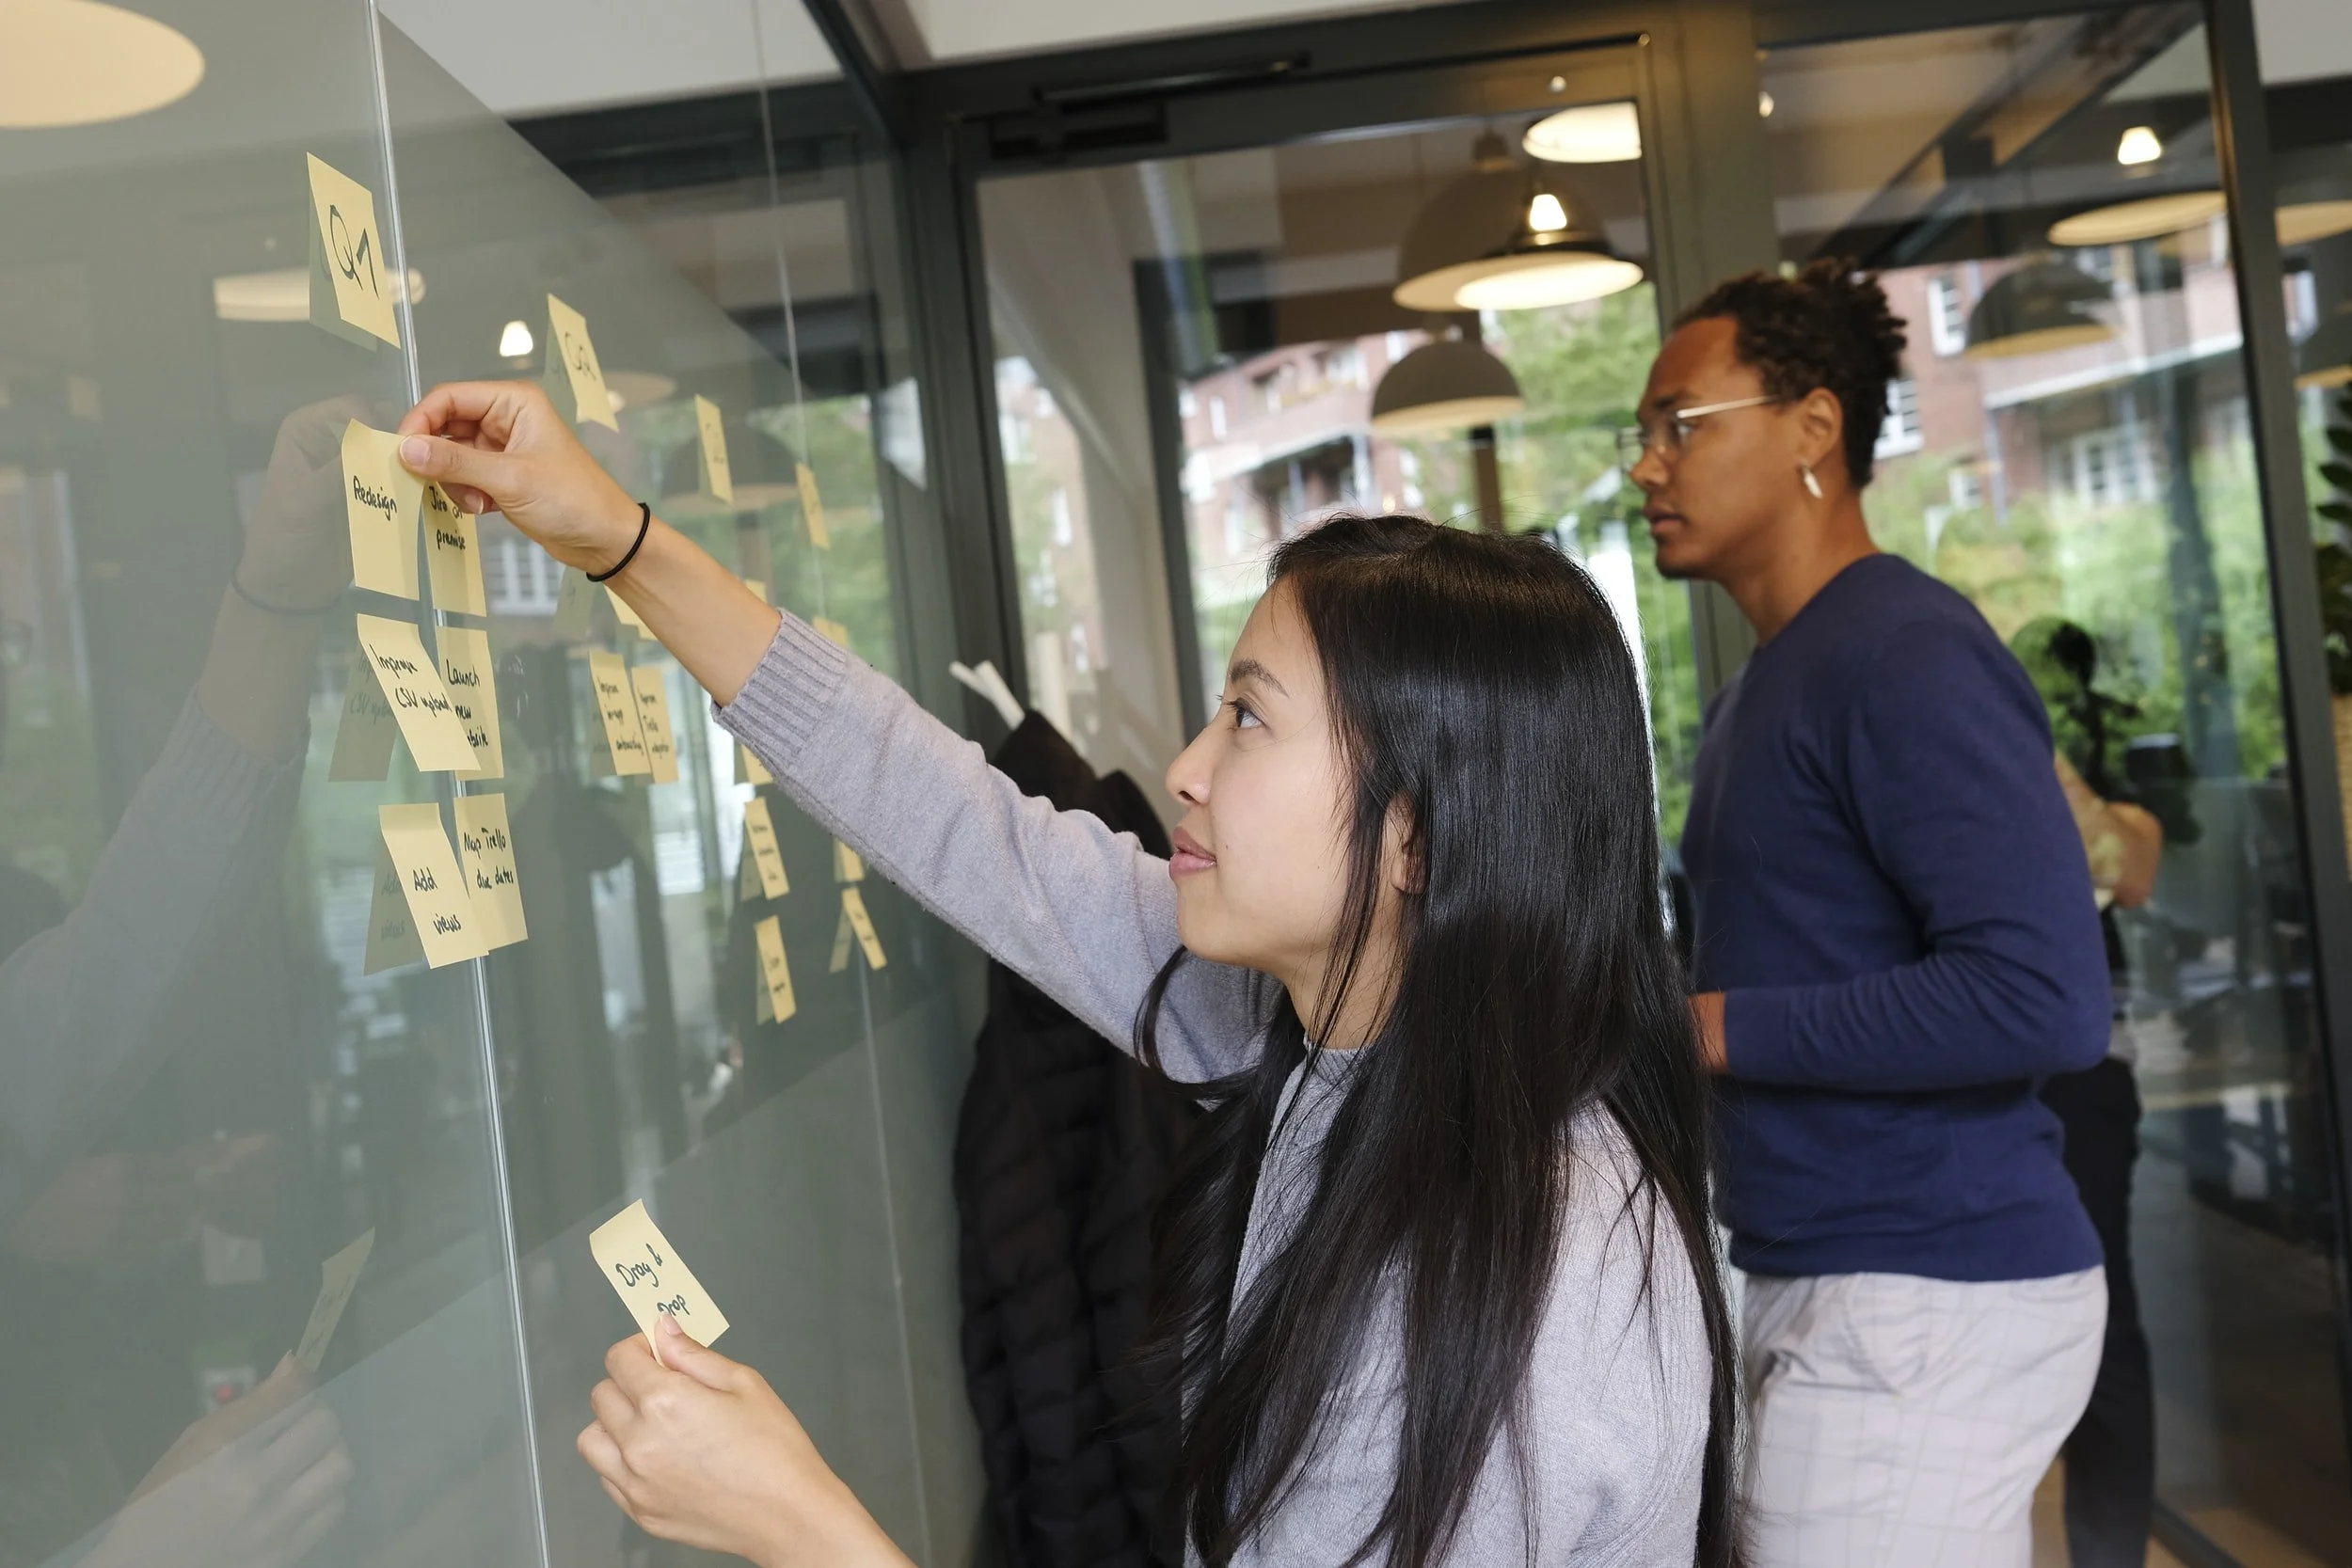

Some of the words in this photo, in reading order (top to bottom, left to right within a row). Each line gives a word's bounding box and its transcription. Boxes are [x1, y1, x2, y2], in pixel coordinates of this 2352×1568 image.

[329, 203, 380, 301] Q1
[353, 475, 398, 521] Redesign
[369, 643, 419, 679] Improve
[446, 658, 481, 689] Launch
[395, 687, 419, 708] CSV
[420, 691, 453, 718] upload
[454, 705, 471, 721] new
[464, 832, 482, 860] Map
[481, 827, 506, 852] Trello
[412, 866, 439, 892] Add
[476, 868, 492, 889] due
[495, 865, 514, 885] dates
[433, 913, 462, 935] views
[615, 1262, 660, 1288] Drag
